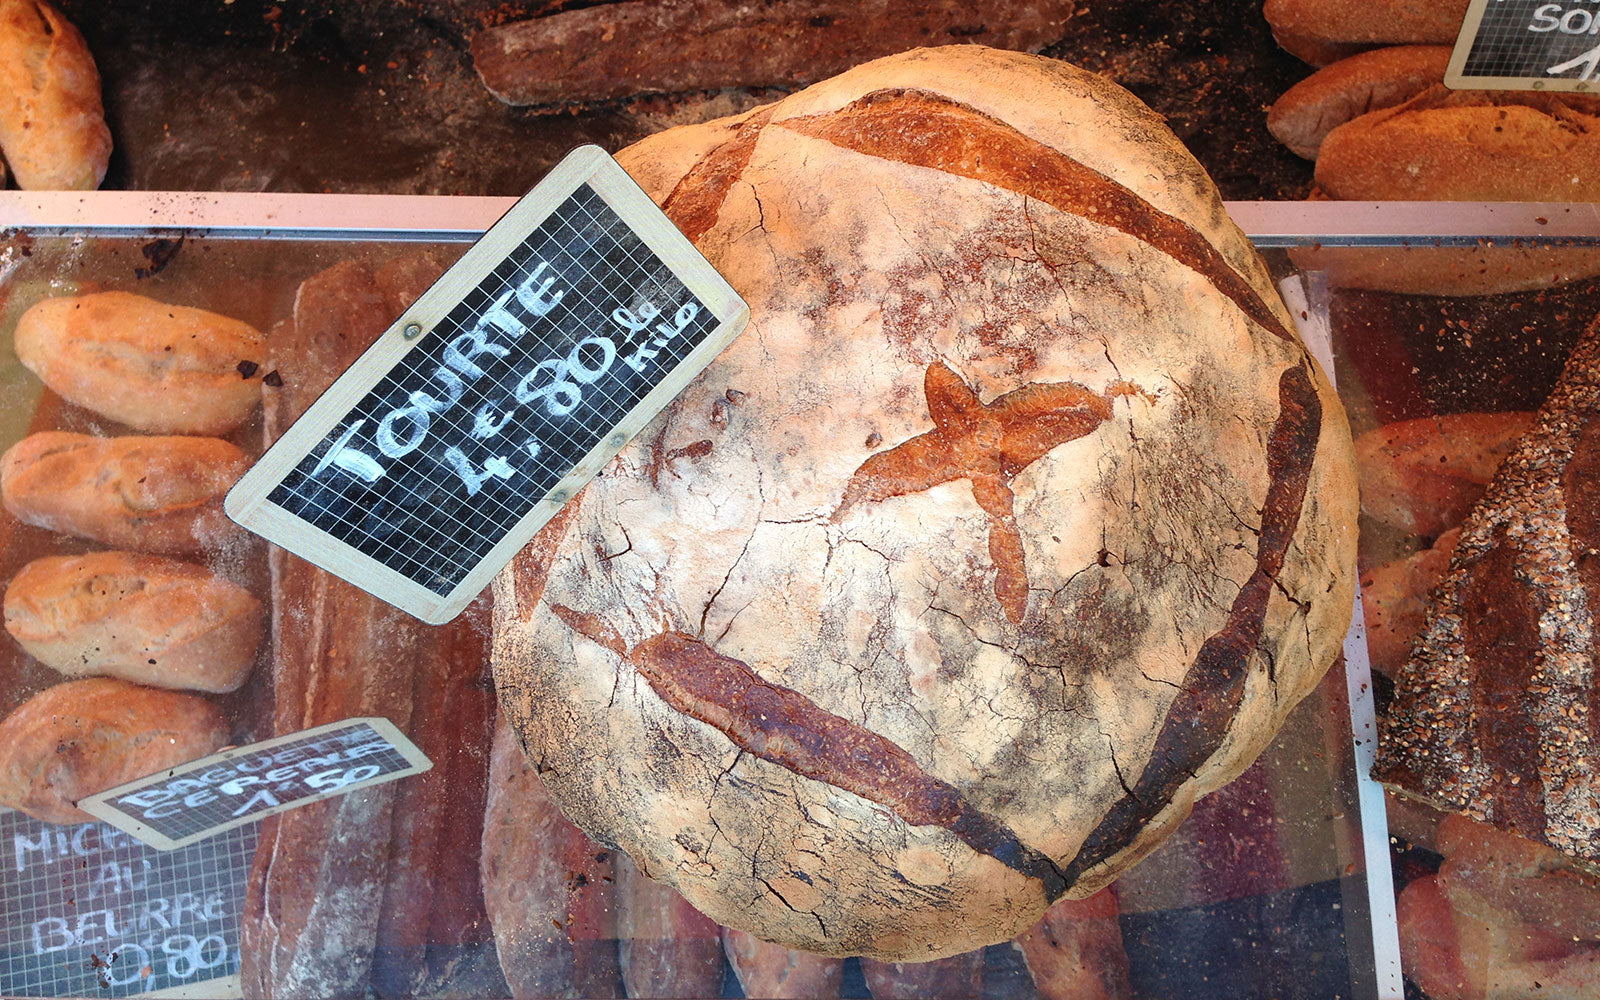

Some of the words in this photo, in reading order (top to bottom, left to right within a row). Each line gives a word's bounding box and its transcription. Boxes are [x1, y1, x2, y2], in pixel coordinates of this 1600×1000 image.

[310, 261, 565, 482] TOURTE
[14, 823, 146, 872] MICH
[89, 859, 151, 899] AU
[32, 891, 226, 955] BEURRE
